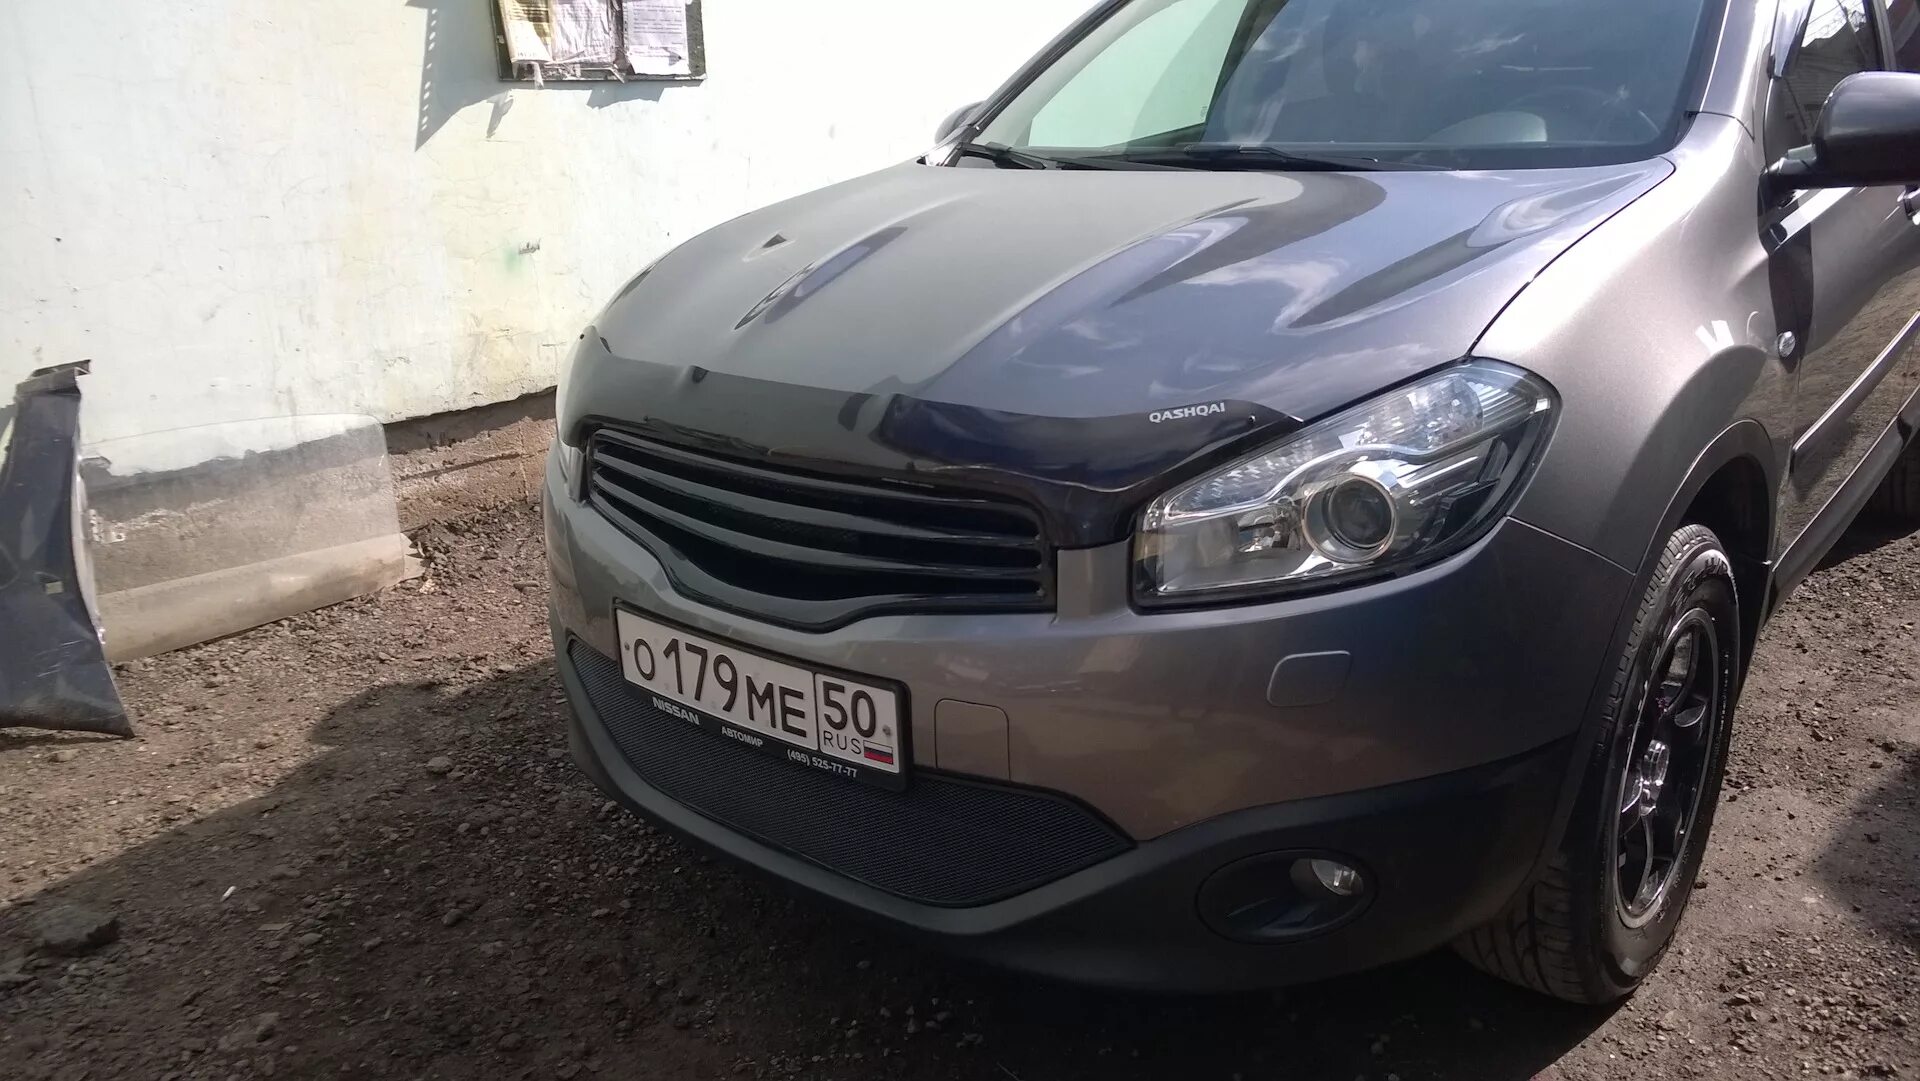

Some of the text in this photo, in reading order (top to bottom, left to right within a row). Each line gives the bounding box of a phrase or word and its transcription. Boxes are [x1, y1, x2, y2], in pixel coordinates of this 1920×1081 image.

[1149, 402, 1225, 423] QASHQAI
[652, 696, 700, 725] NISSAN
[823, 681, 876, 738] 50
[721, 726, 763, 747] АВТОМИР
[823, 730, 861, 755] RUS
[787, 749, 857, 778] (495) 525-77-77
